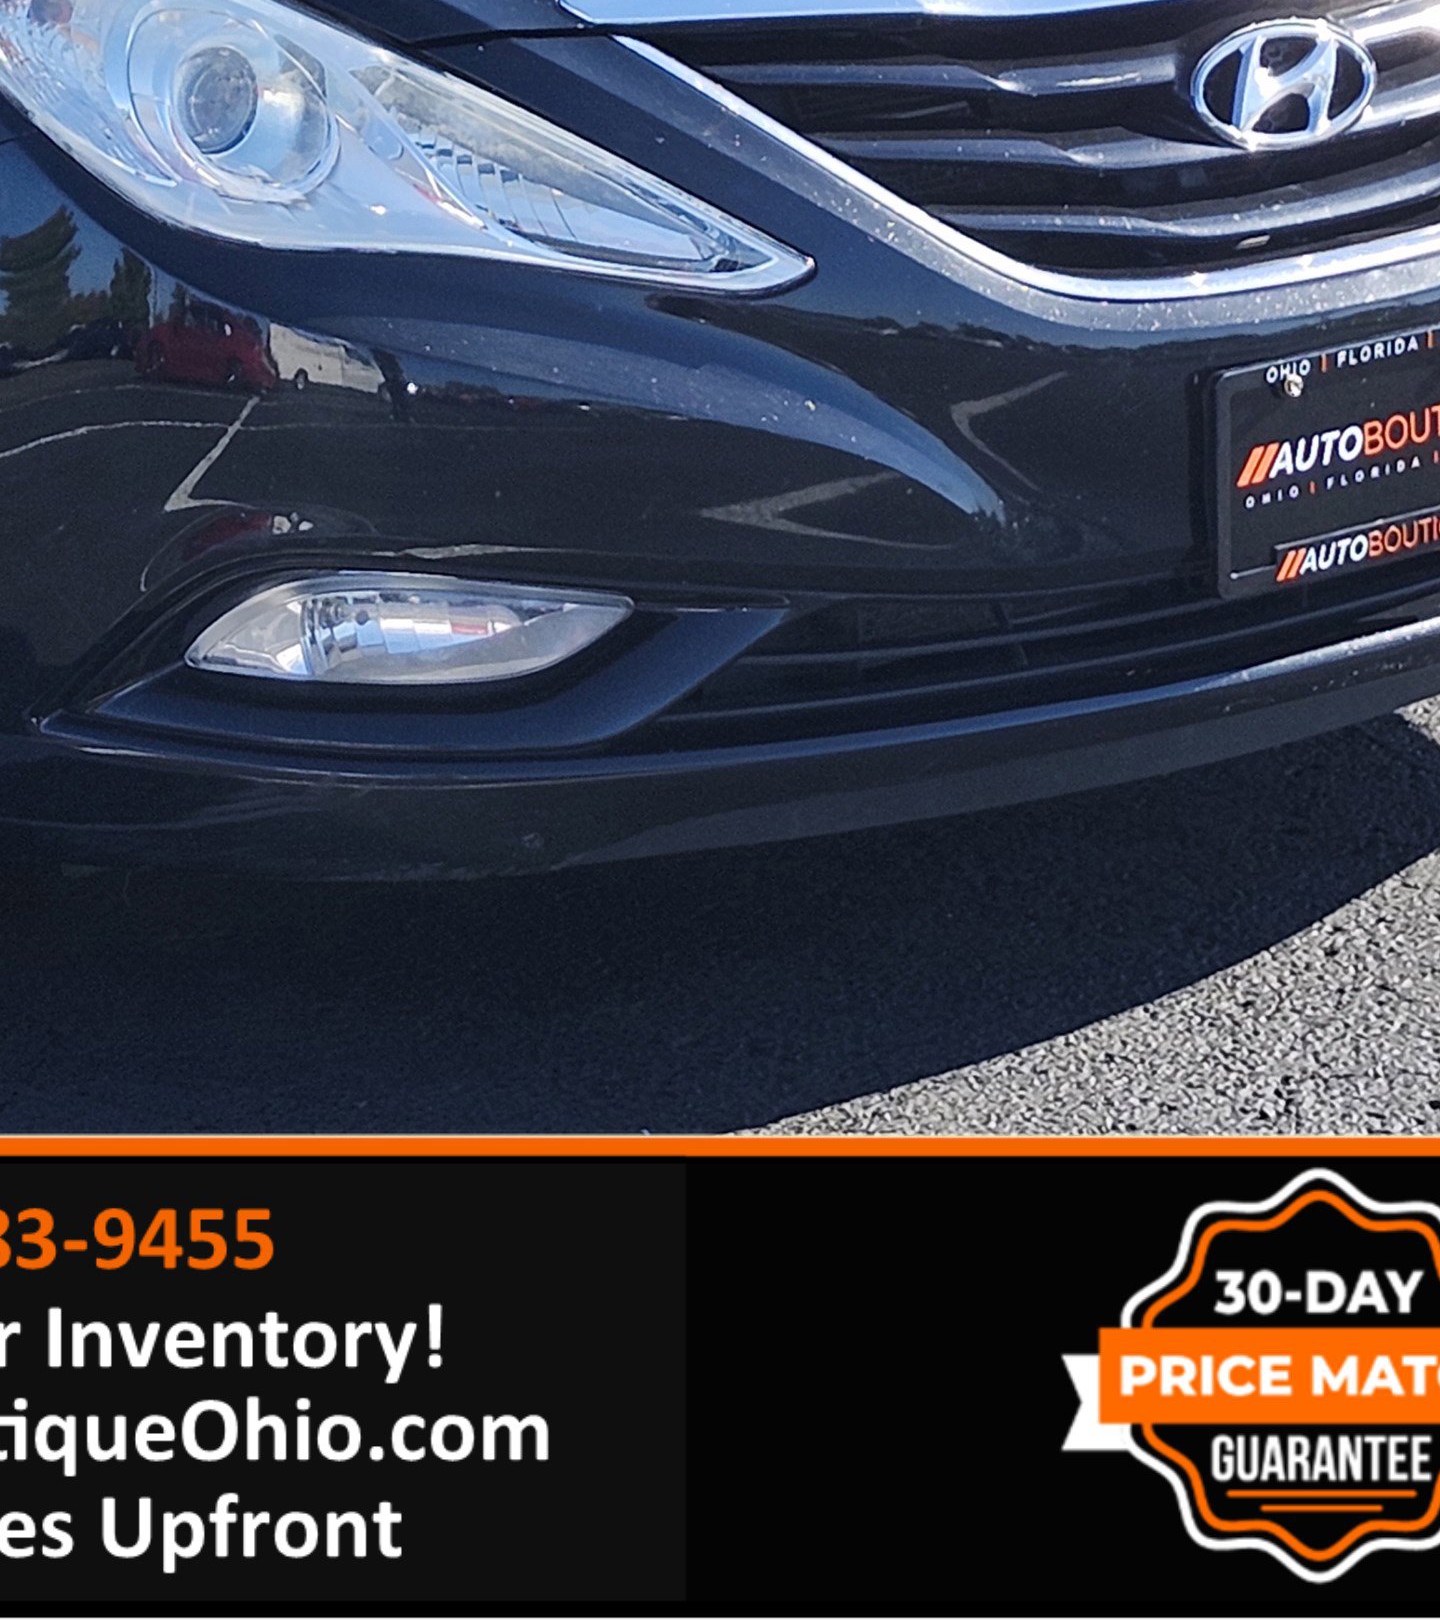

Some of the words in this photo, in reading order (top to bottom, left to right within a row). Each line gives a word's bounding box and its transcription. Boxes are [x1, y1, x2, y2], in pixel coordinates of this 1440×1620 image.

[1265, 358, 1312, 383] OHIO
[1337, 336, 1419, 368] FLORIDA
[1245, 485, 1299, 508] OHIO
[1326, 456, 1420, 490] FLORIDA
